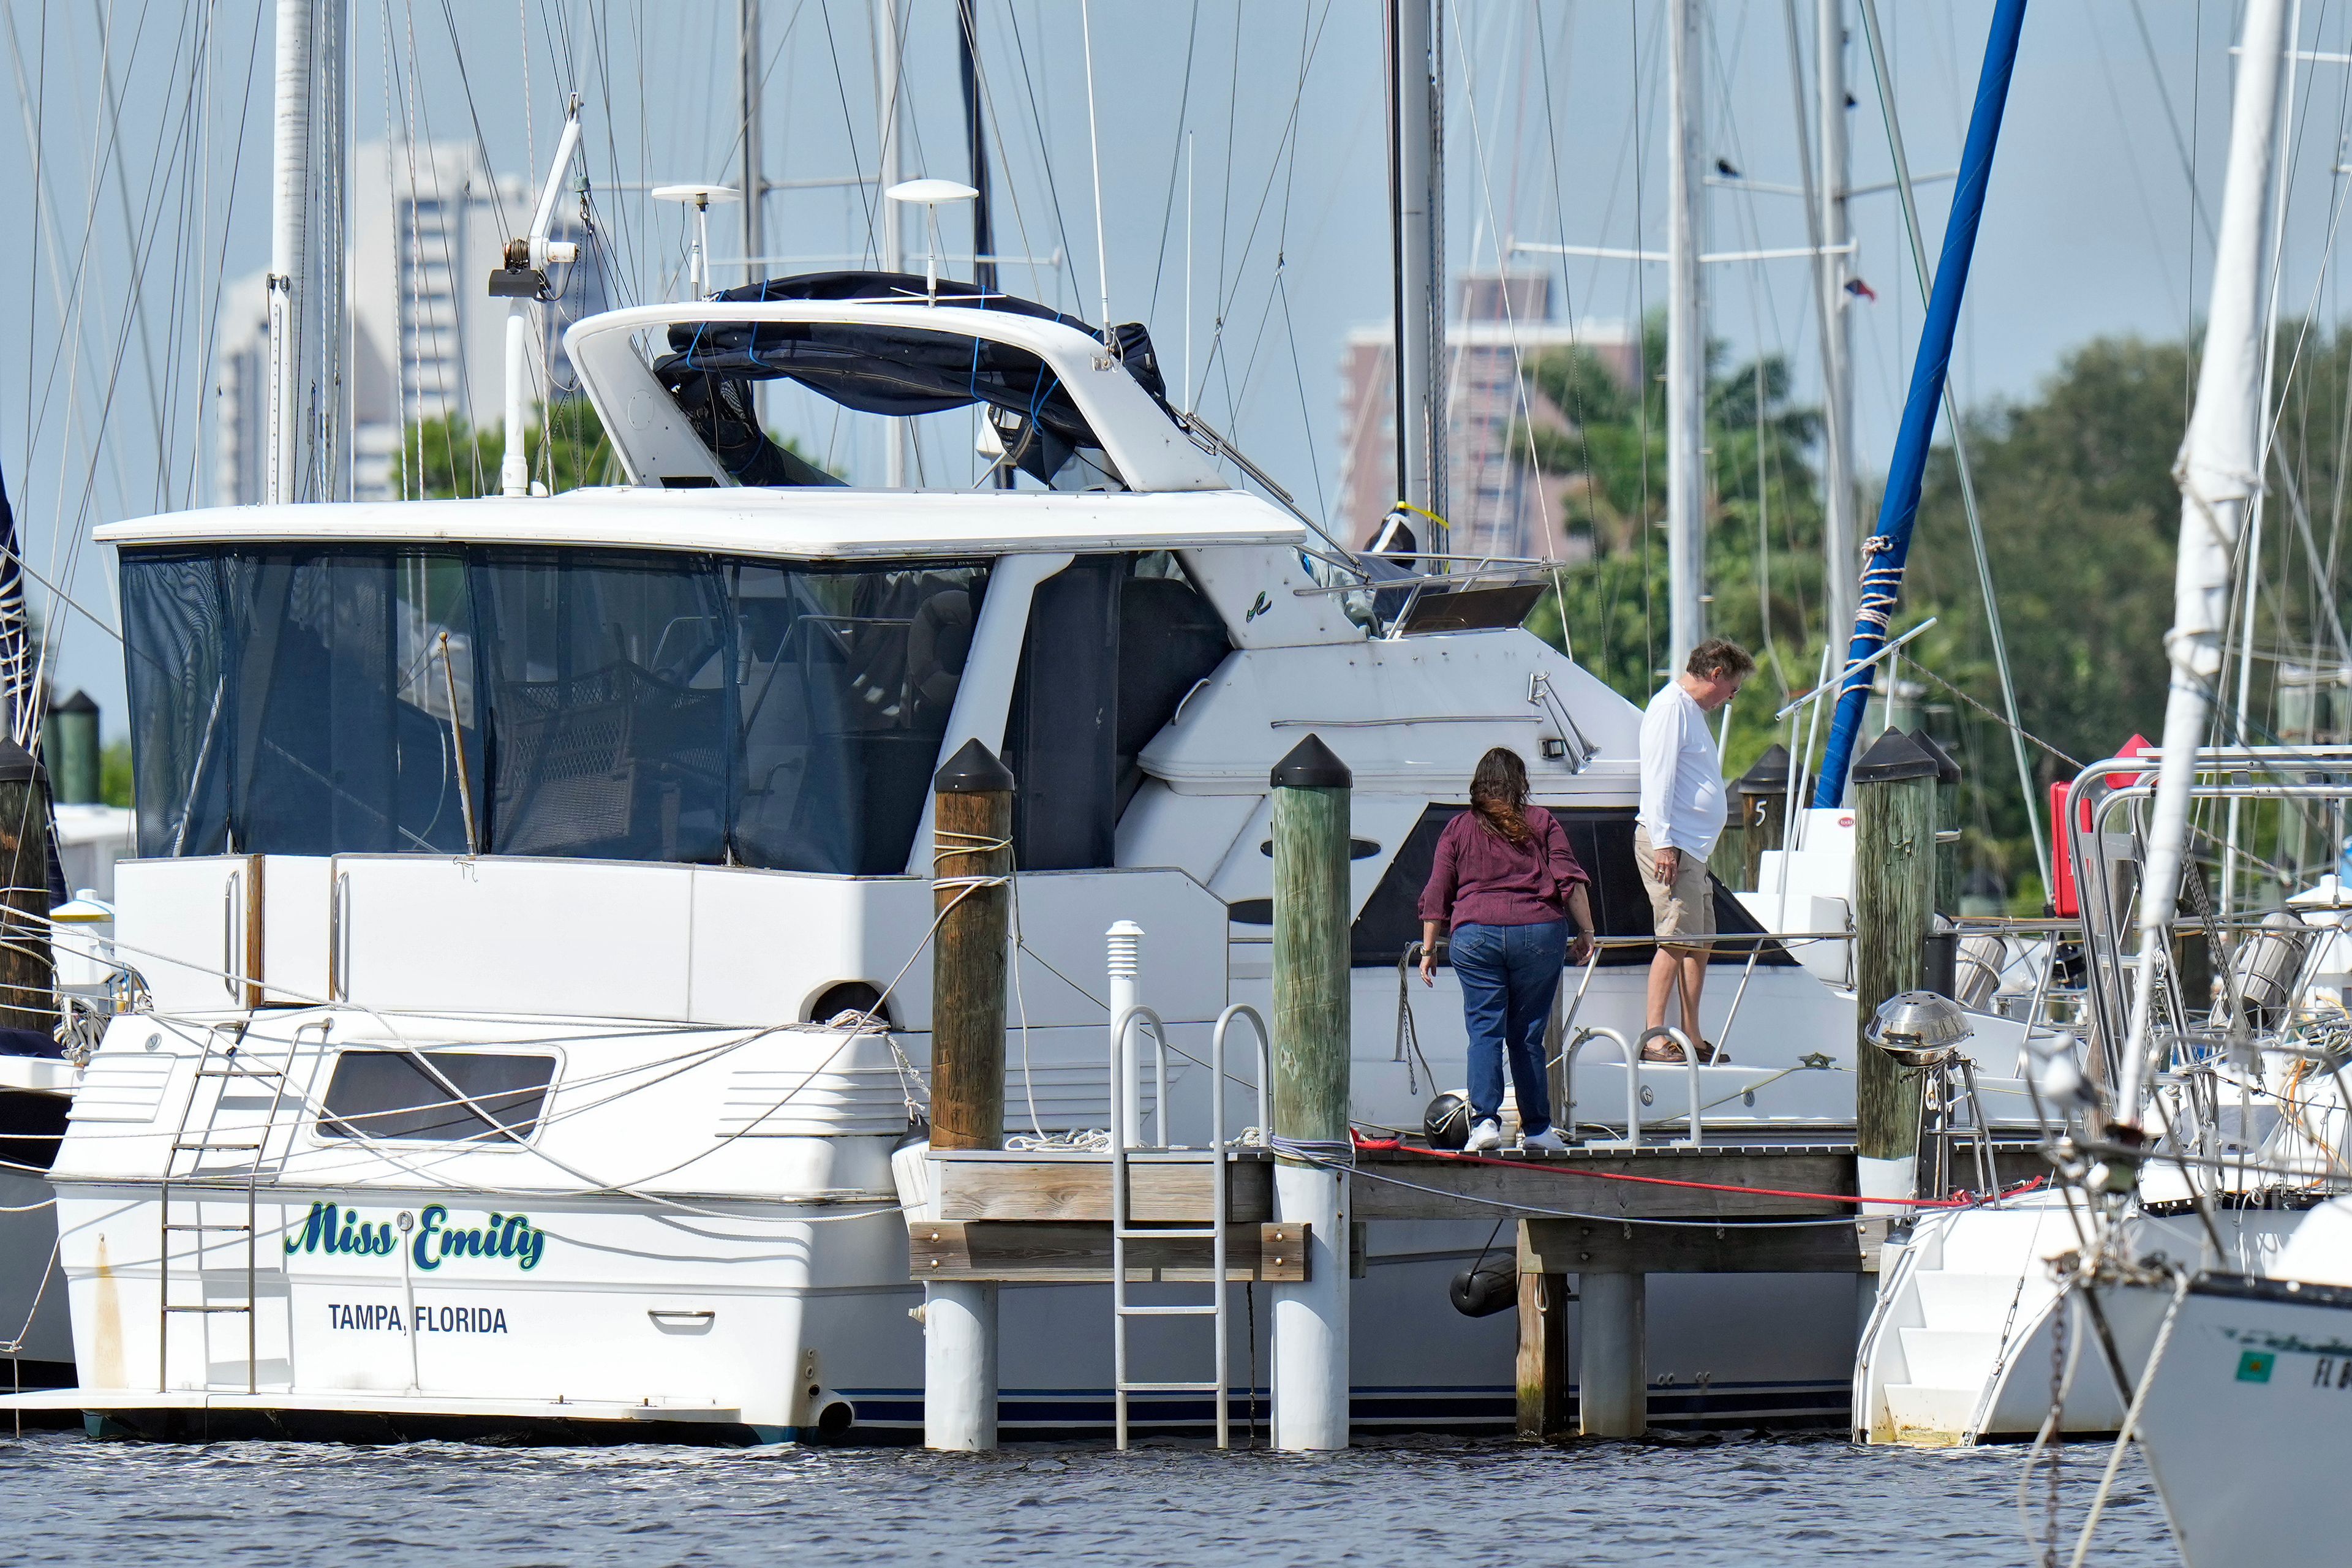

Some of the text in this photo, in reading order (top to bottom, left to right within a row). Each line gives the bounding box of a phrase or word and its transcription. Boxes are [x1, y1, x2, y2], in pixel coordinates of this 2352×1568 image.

[1755, 800, 1768, 827] 5
[284, 1200, 546, 1272] Miss Emily
[328, 1304, 508, 1336] TAMPA, FLORIDA
